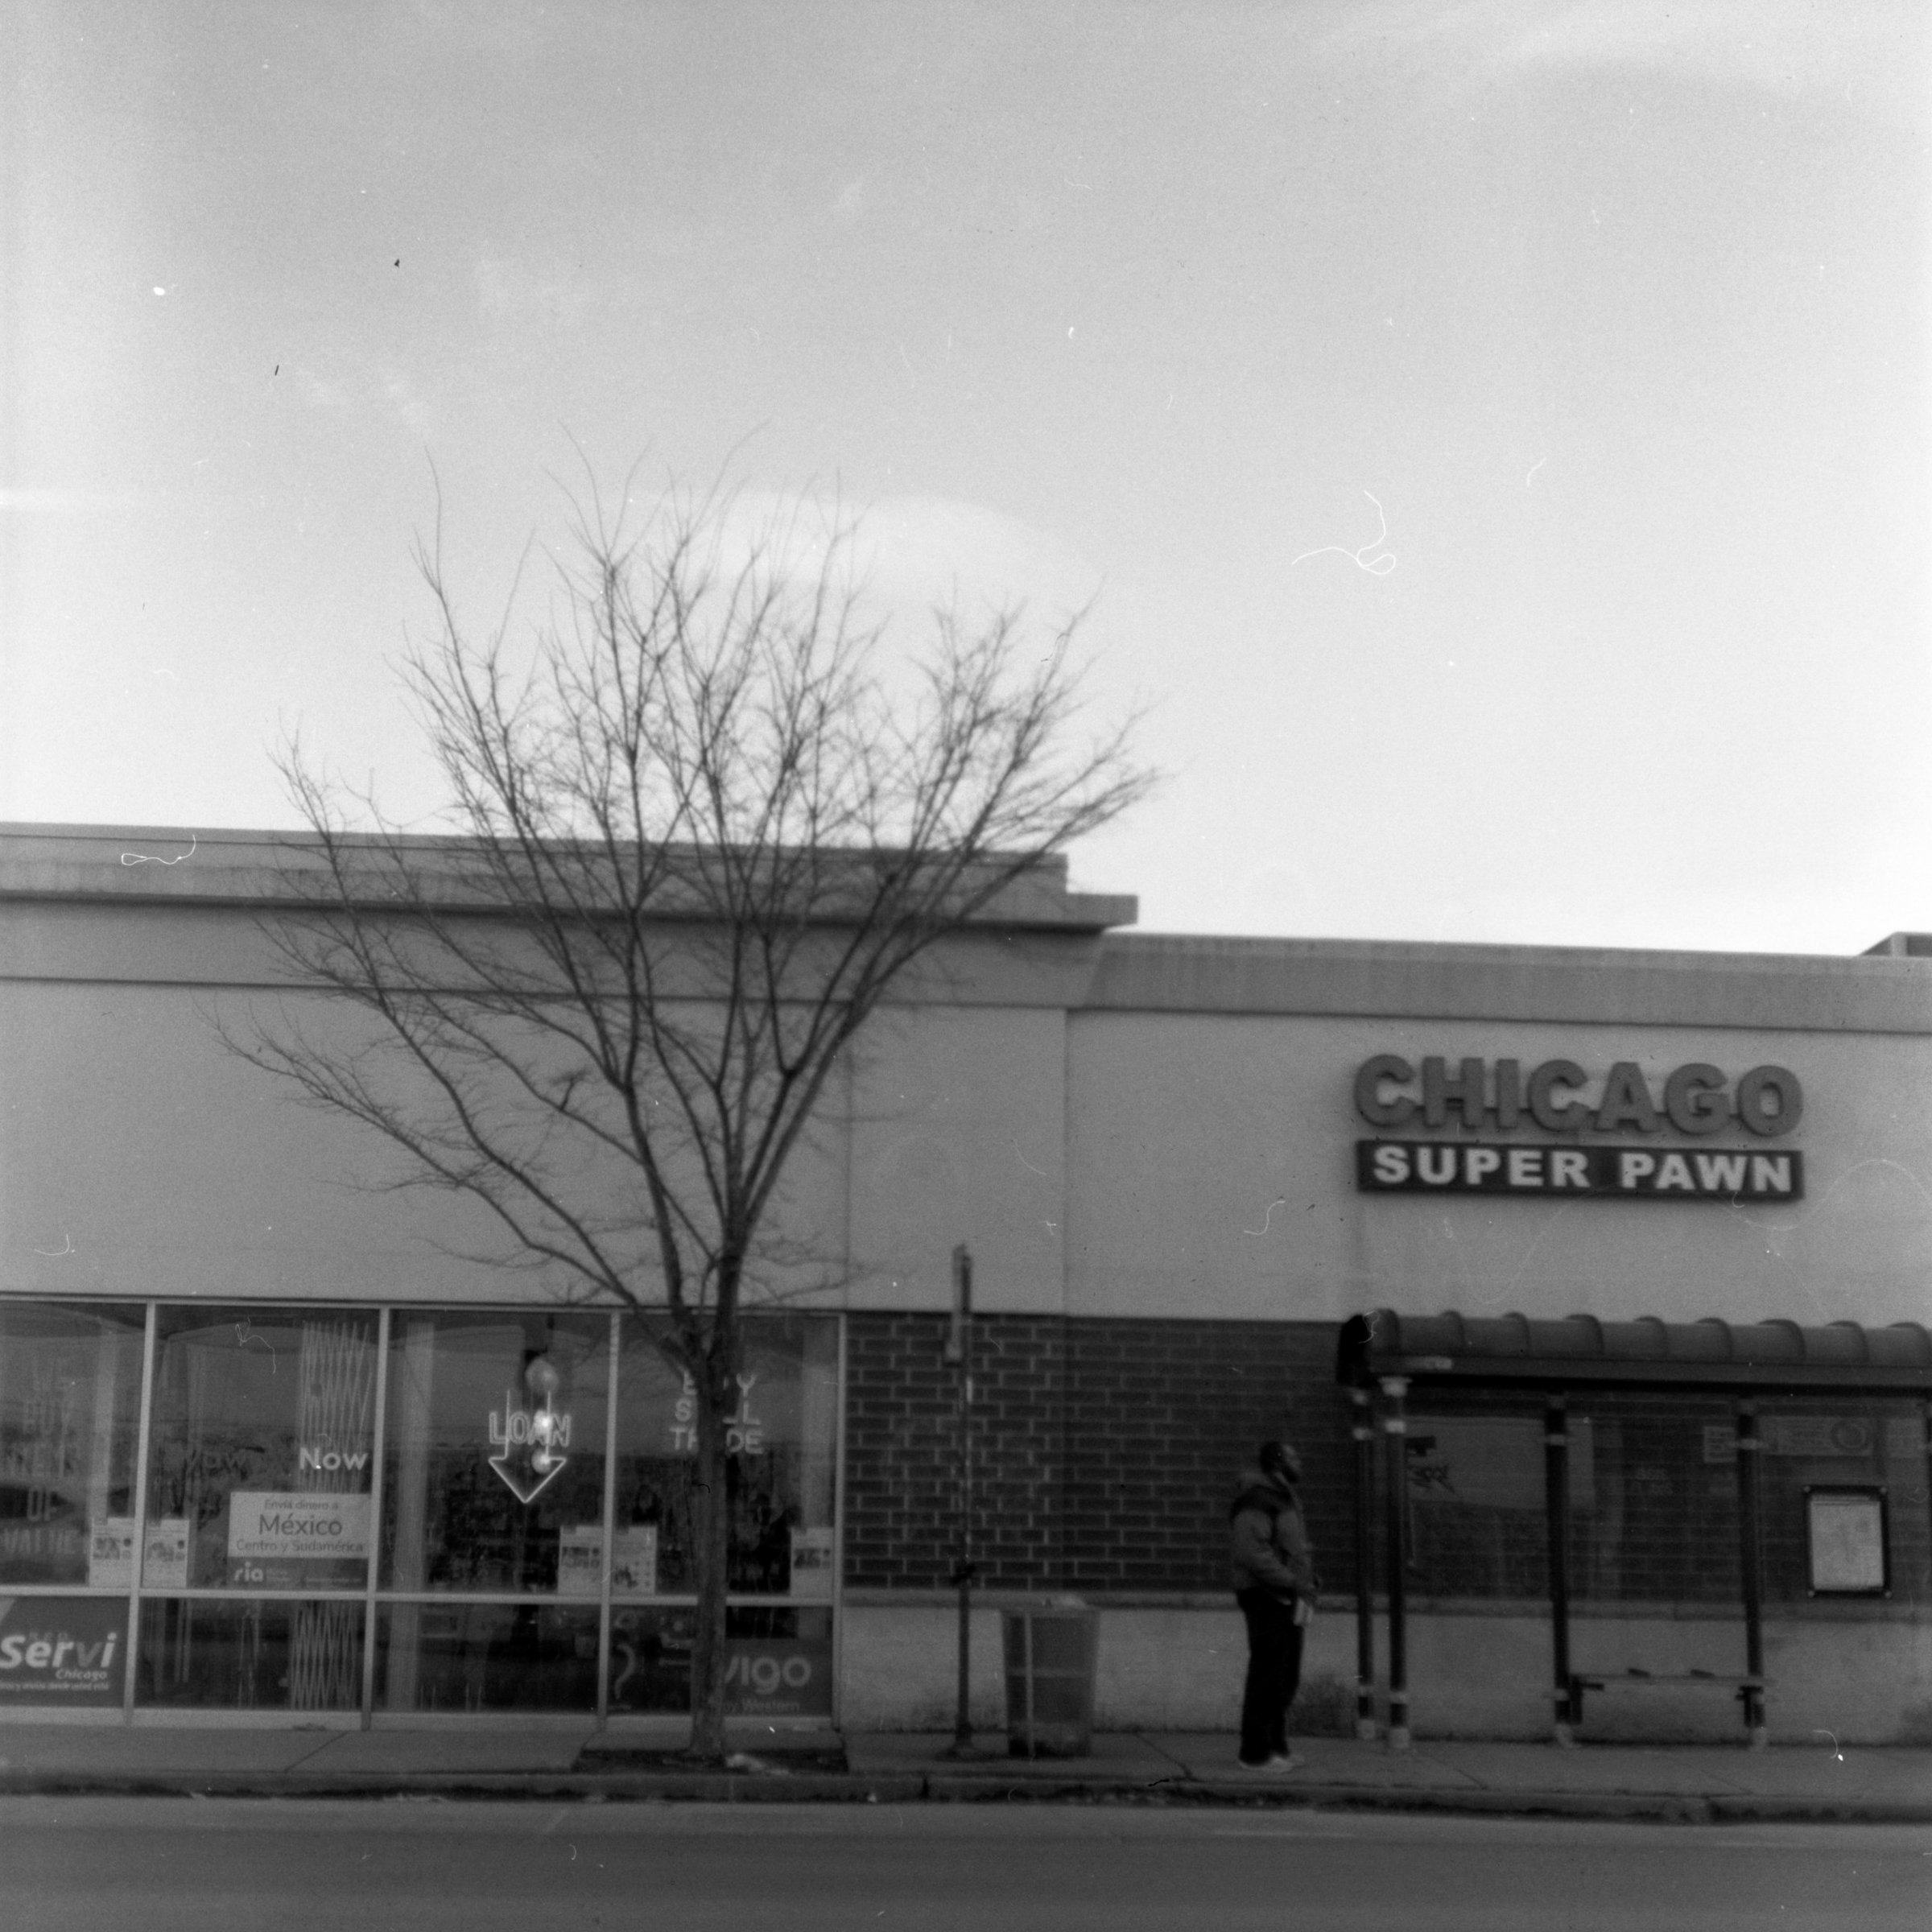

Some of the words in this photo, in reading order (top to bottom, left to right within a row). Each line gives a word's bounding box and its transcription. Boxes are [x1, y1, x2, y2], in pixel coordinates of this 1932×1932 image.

[1355, 1053, 1804, 1137] CHICAGO
[1373, 1145, 1591, 1187] SUPER
[1620, 1152, 1792, 1192] PAWN
[488, 1410, 571, 1447] LOAN
[299, 1447, 368, 1471] Now
[258, 1513, 343, 1536] México
[237, 1539, 277, 1551] Centro
[281, 1542, 288, 1552] y
[233, 1561, 264, 1583] ria
[0, 1632, 118, 1670] Servi
[56, 1669, 108, 1682] Chicago
